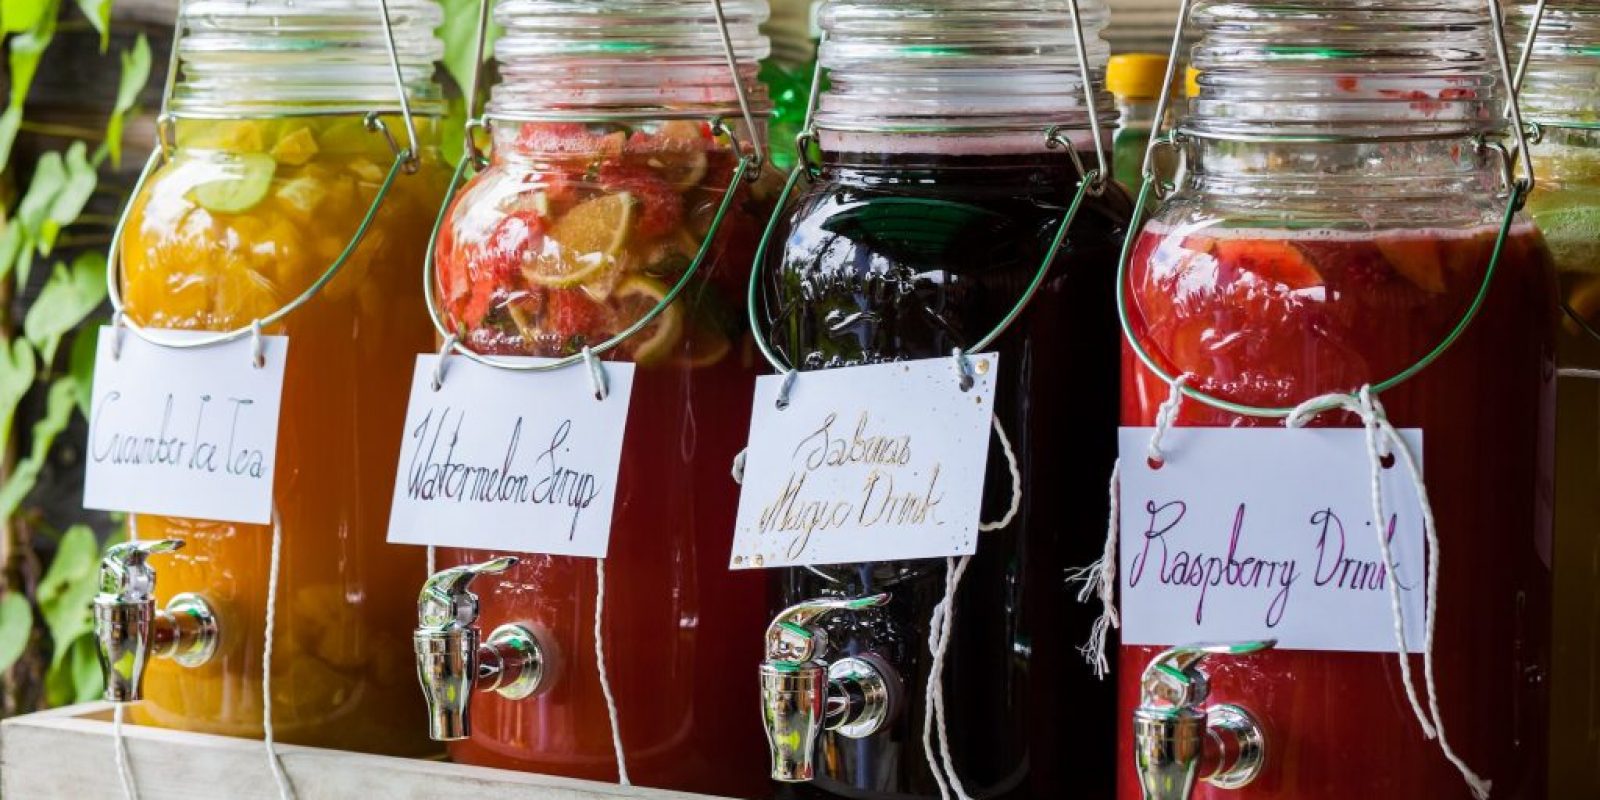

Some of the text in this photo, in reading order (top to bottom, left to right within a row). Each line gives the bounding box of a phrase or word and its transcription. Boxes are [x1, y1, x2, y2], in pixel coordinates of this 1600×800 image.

[187, 394, 217, 472] Ice
[225, 396, 265, 479] Tea
[407, 406, 603, 541] Watermelon Sirup
[758, 462, 946, 561] Magic Drink
[1129, 500, 1301, 628] Raspberry
